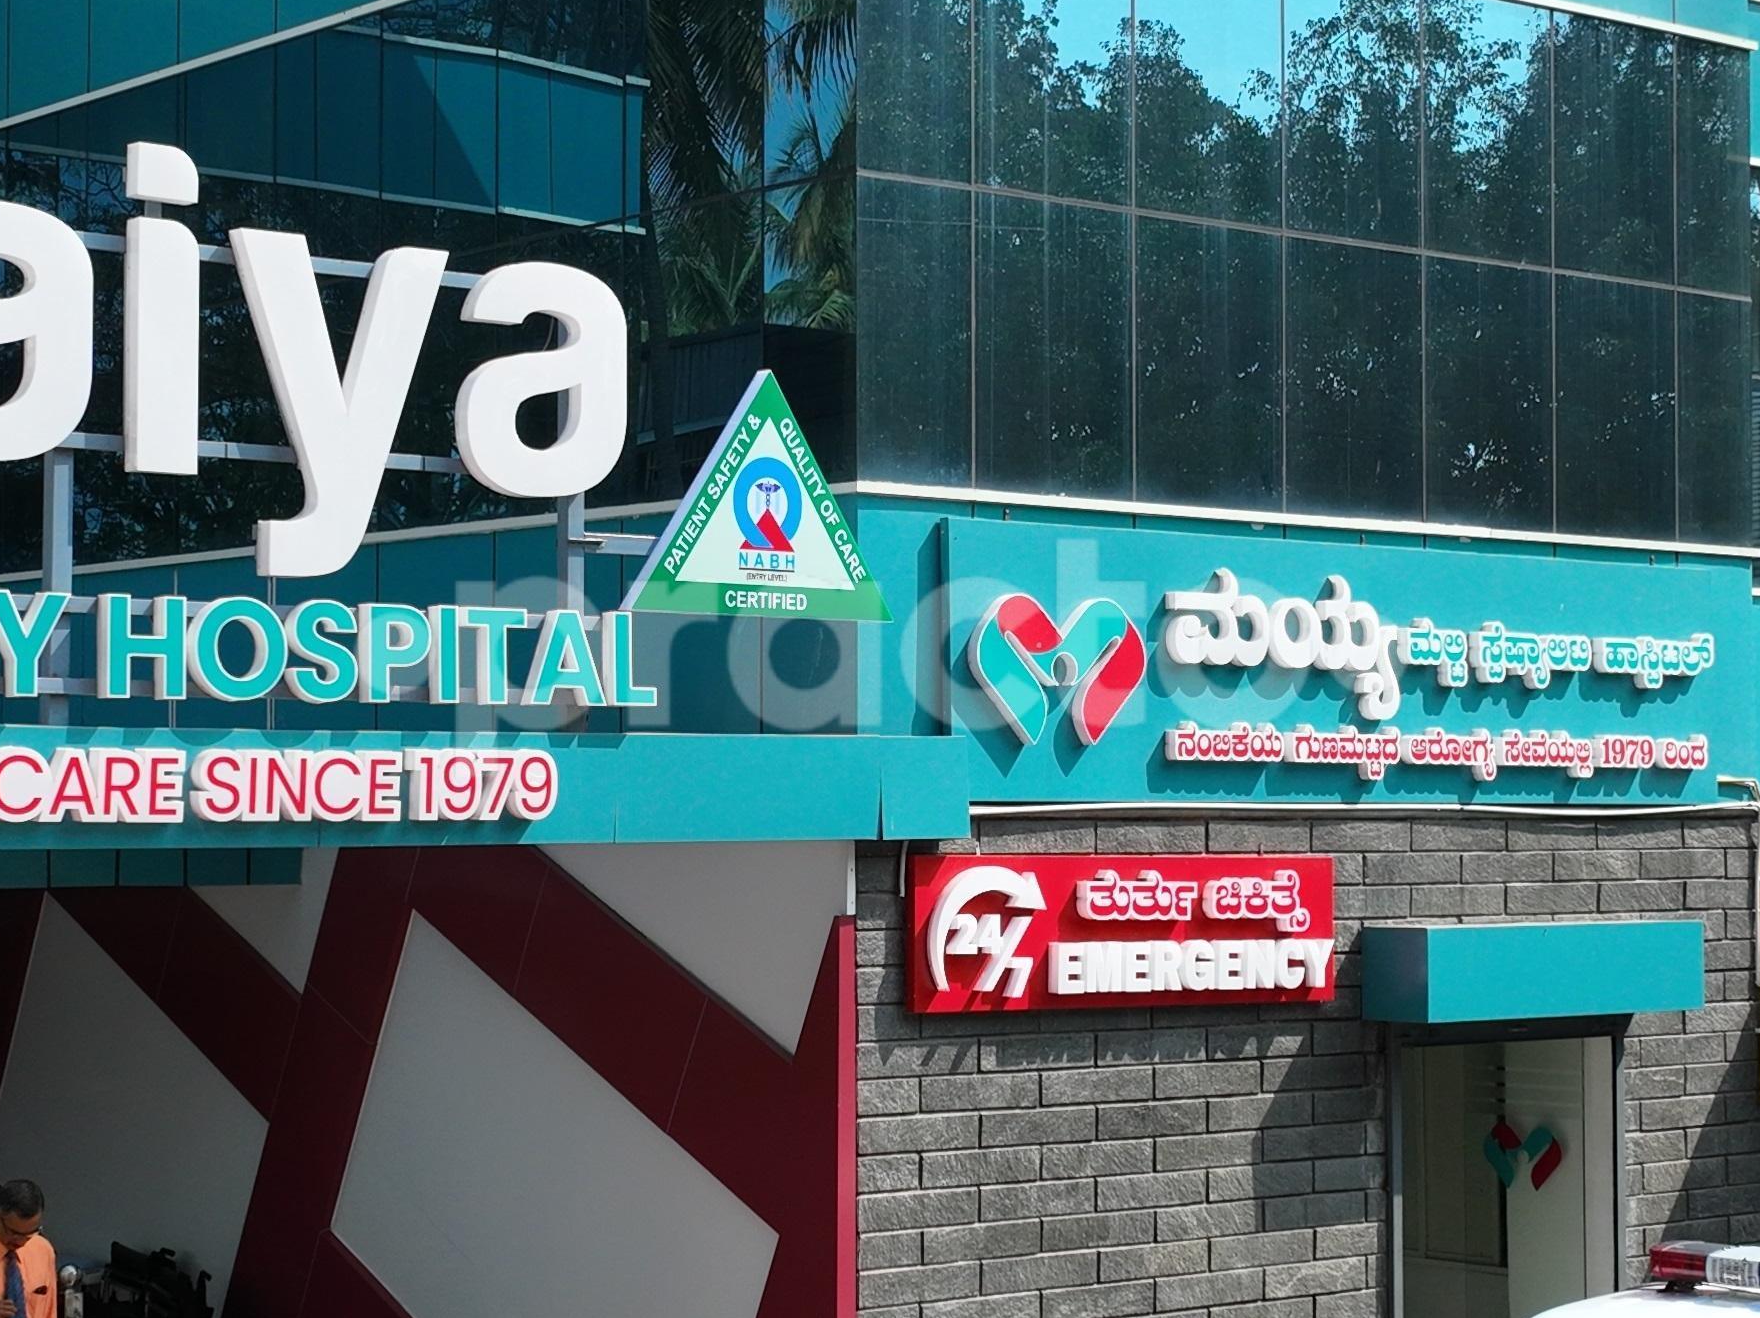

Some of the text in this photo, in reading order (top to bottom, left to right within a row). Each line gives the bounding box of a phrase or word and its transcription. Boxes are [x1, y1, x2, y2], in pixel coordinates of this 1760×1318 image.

[664, 414, 761, 574] PATIENT SAFETY &
[779, 418, 866, 583] QUALITY OF CARE
[739, 552, 795, 569] NABH
[725, 590, 807, 611] CERTIFIED
[97, 592, 657, 707] HOSPITAL
[1165, 568, 1401, 720] ಮಯ್ಯ
[189, 744, 403, 822] SINCE
[406, 748, 558, 822] 1979
[1168, 721, 1284, 761] ನಂಬಿಕೆಯ
[1287, 724, 1401, 780] ಗುಣಮಟ್ಟದ
[1405, 728, 1496, 780] ಆರೋಗ್ಯ
[1596, 735, 1655, 768] 1979
[1658, 735, 1708, 769] ರಿಂದ
[1048, 939, 1334, 995] EMERGENCY
